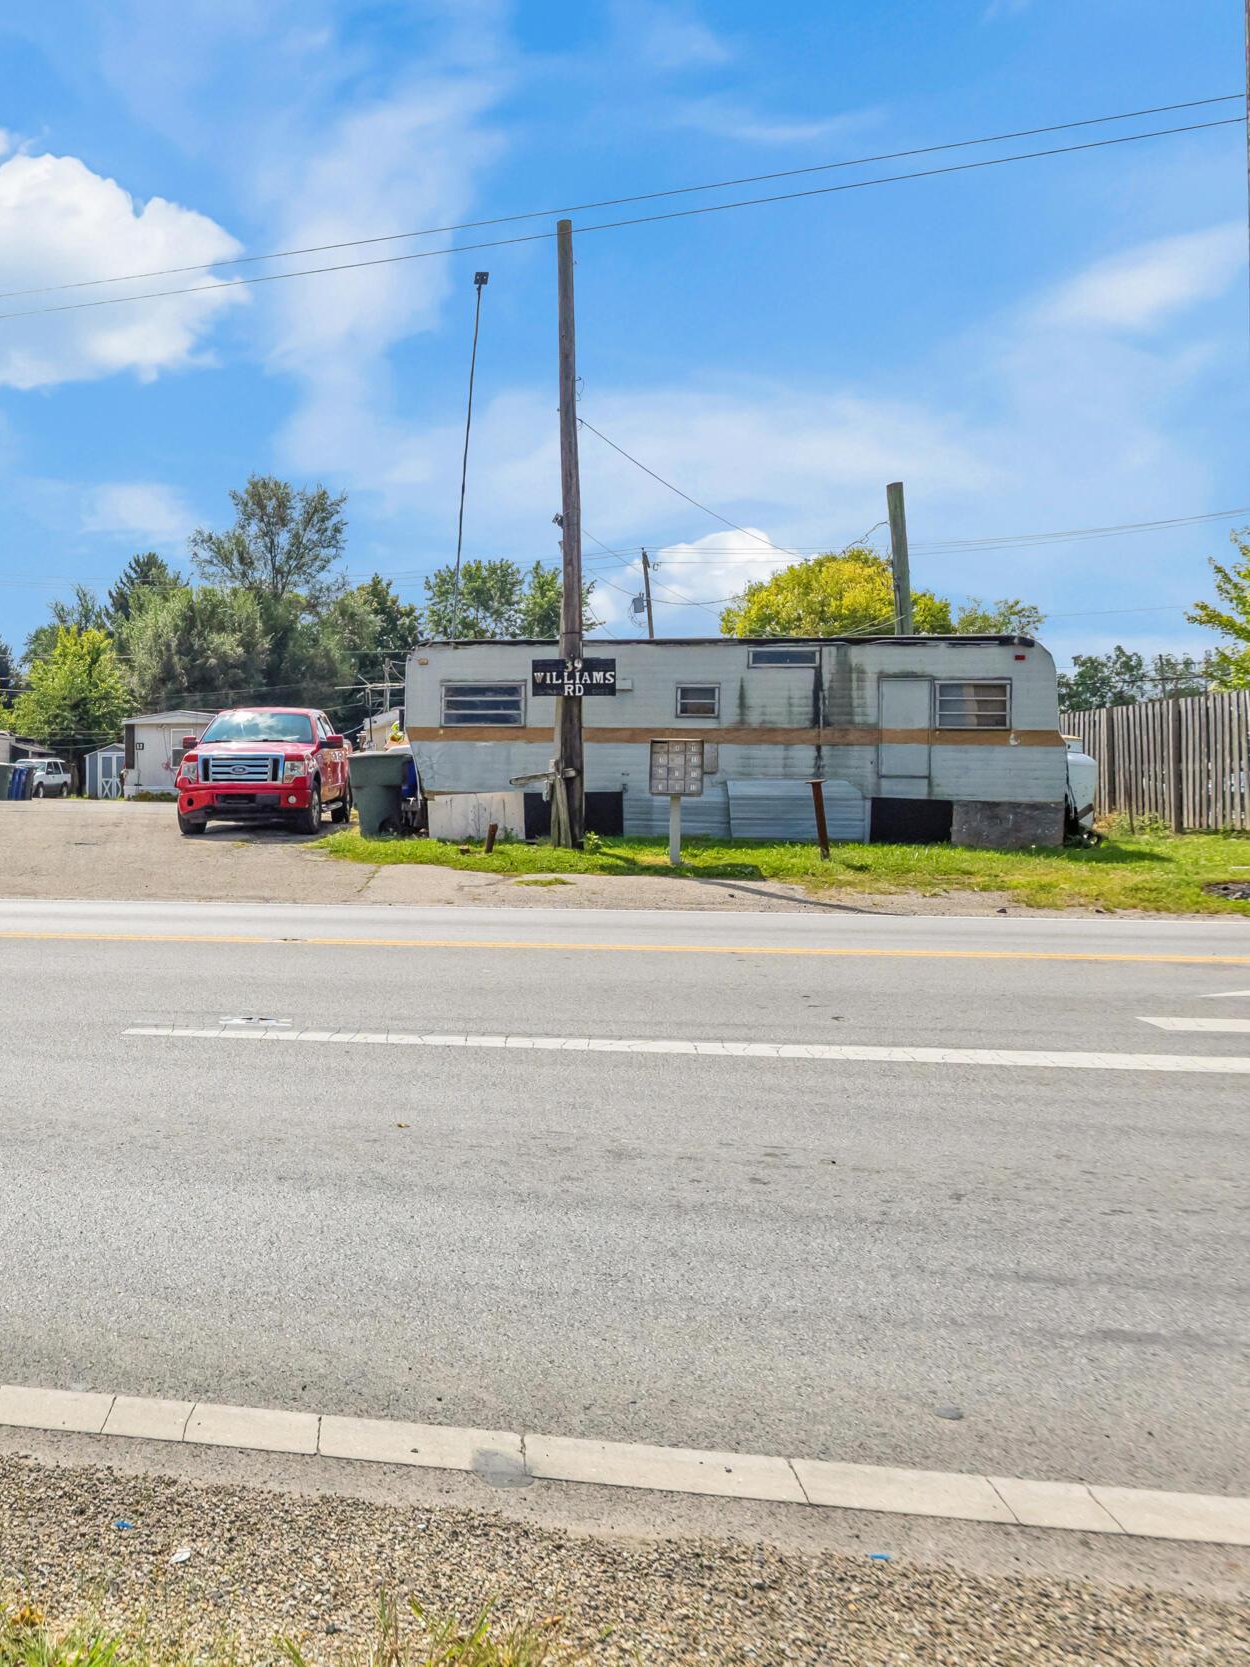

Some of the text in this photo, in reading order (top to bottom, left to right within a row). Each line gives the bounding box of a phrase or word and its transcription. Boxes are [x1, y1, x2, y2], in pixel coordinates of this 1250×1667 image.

[564, 658, 582, 671] 39
[533, 671, 615, 684] WILLIAMS
[564, 684, 584, 696] RD
